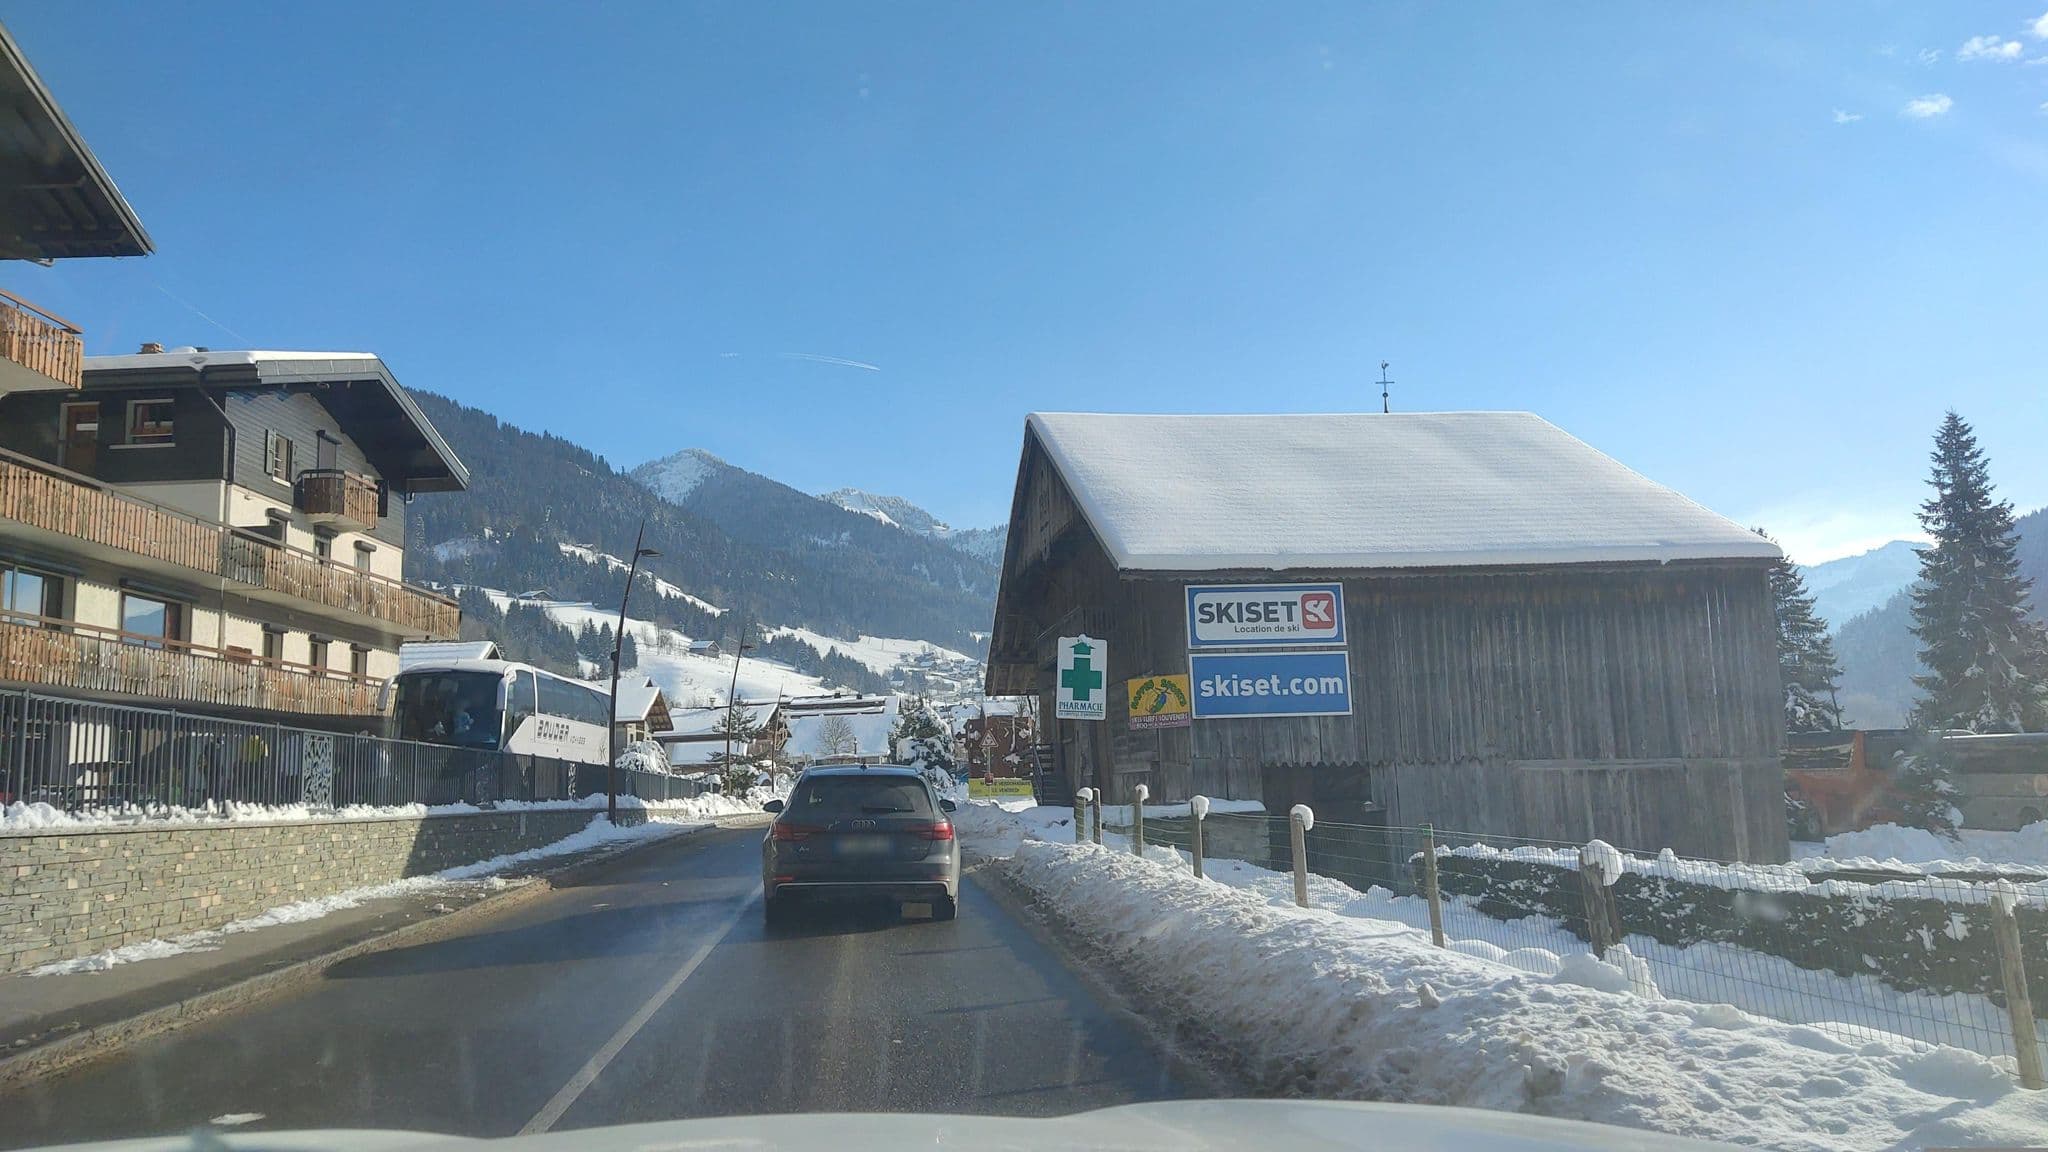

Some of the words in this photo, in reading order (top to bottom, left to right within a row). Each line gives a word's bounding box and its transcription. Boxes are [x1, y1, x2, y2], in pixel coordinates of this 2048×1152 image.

[1198, 601, 1298, 624] SKISET
[1234, 625, 1272, 633] Location
[1274, 625, 1285, 633] de
[1287, 624, 1300, 633] ski
[1200, 674, 1344, 697] skiset.com
[1059, 701, 1104, 712] PHARMACIE
